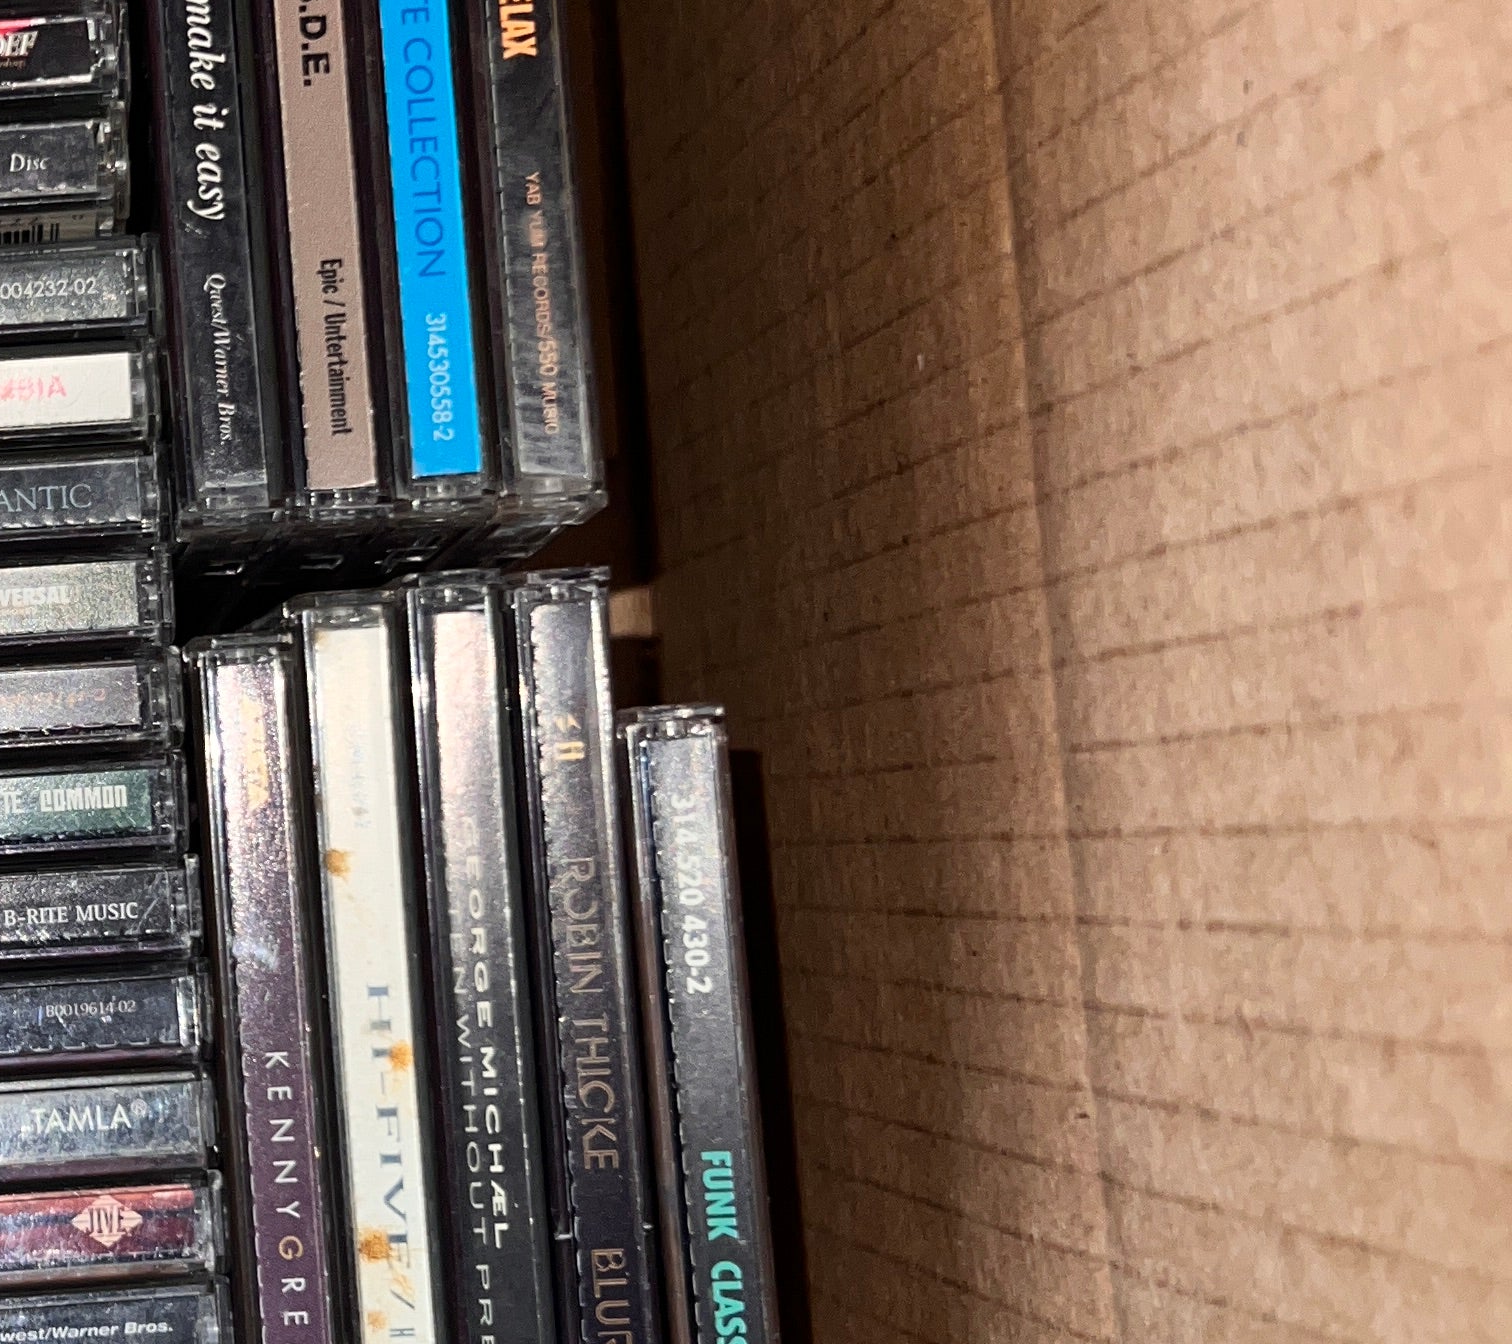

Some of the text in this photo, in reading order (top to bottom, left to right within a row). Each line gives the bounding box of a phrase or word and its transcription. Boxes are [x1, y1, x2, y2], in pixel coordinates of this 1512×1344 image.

[187, 143, 226, 222] easy
[402, 37, 446, 279] COLLECTION
[320, 258, 343, 297] Epic
[324, 313, 351, 436] Untertainment
[3, 906, 67, 927] B-RITE
[73, 902, 138, 923] MUSIC
[263, 1051, 301, 1219] KENNY
[570, 1017, 620, 1170] THICKE
[701, 1149, 739, 1240] FUNK
